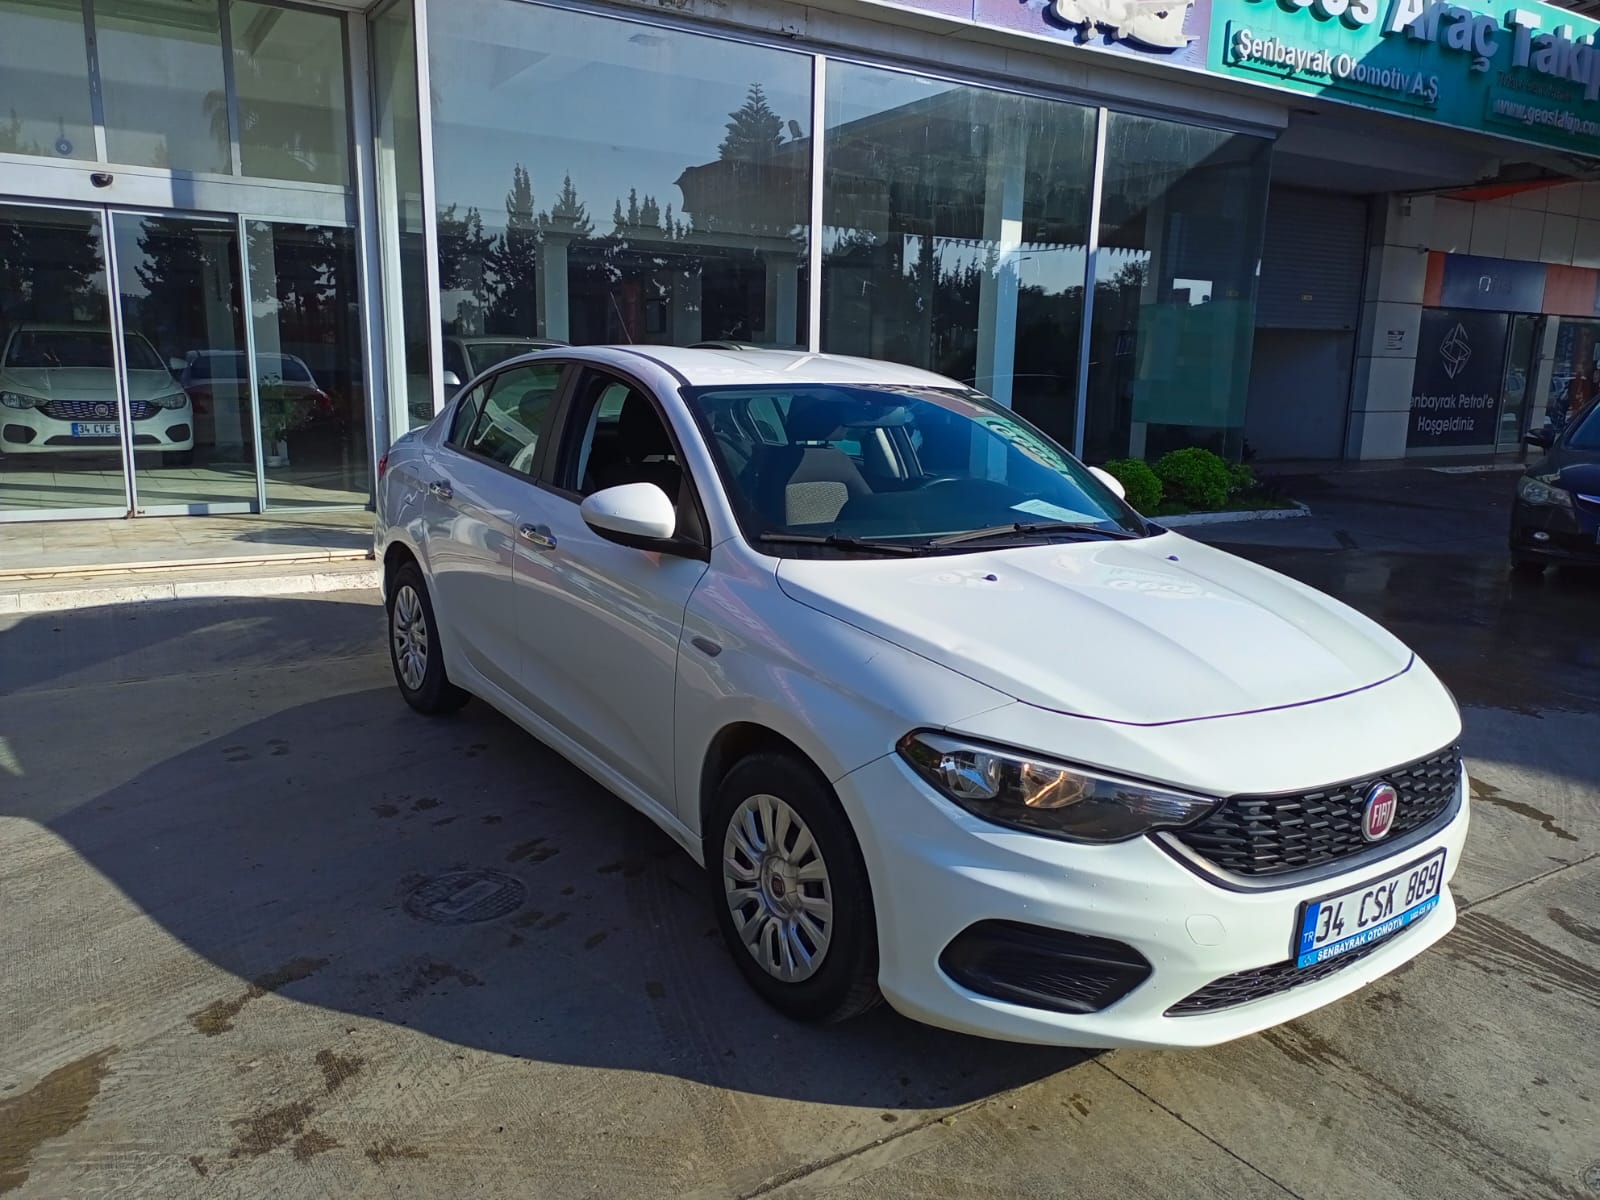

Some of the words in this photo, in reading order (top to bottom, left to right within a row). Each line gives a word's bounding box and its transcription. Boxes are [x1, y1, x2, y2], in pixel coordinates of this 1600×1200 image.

[1387, 0, 1499, 73] Araç
[1237, 29, 1333, 74] Şenbayrak
[1336, 53, 1409, 91] Otomotiv
[1409, 392, 1457, 412] enbayrak
[1458, 393, 1494, 409] Petrol'e
[78, 424, 90, 434] 34
[93, 424, 111, 434] CVE
[1416, 415, 1475, 435] Hoşgeldiniz
[1371, 799, 1393, 829] FIAT
[1315, 901, 1345, 943] 34
[1357, 879, 1400, 928] CSK
[1405, 859, 1440, 906] 889
[1303, 930, 1314, 944] TR
